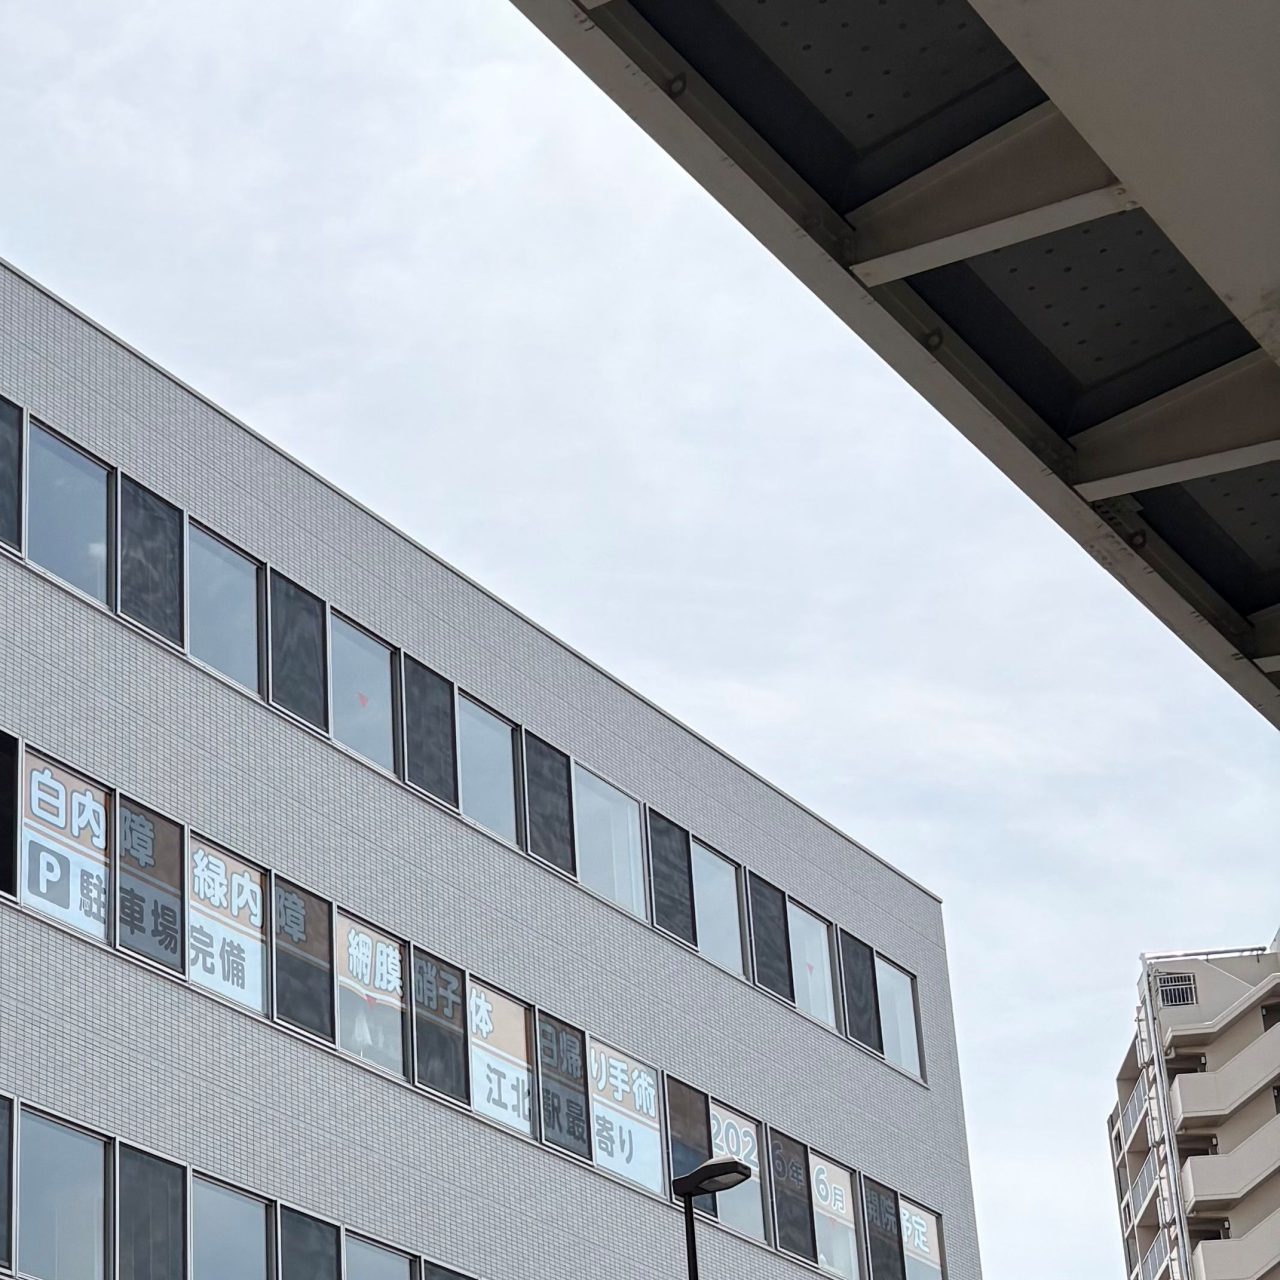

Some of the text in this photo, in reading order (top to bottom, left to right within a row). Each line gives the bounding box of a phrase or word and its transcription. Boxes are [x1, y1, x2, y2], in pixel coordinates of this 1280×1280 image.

[30, 768, 156, 869] 白内障
[79, 867, 246, 990] 駐車場完備
